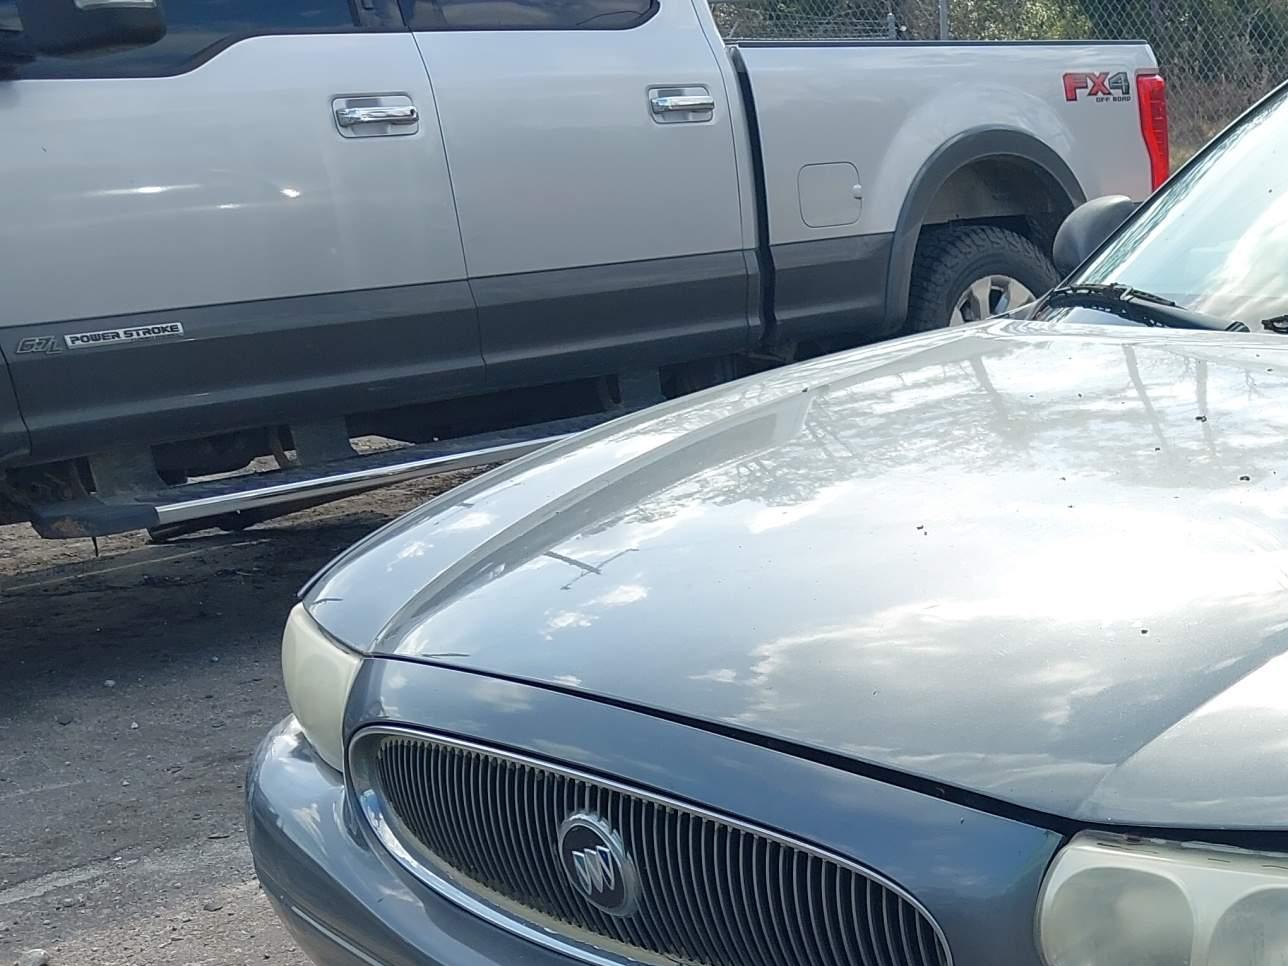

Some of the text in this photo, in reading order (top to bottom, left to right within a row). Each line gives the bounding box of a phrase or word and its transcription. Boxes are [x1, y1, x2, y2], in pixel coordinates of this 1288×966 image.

[1063, 72, 1130, 101] FX4
[70, 331, 121, 345] POWER
[123, 323, 180, 338] STROKE
